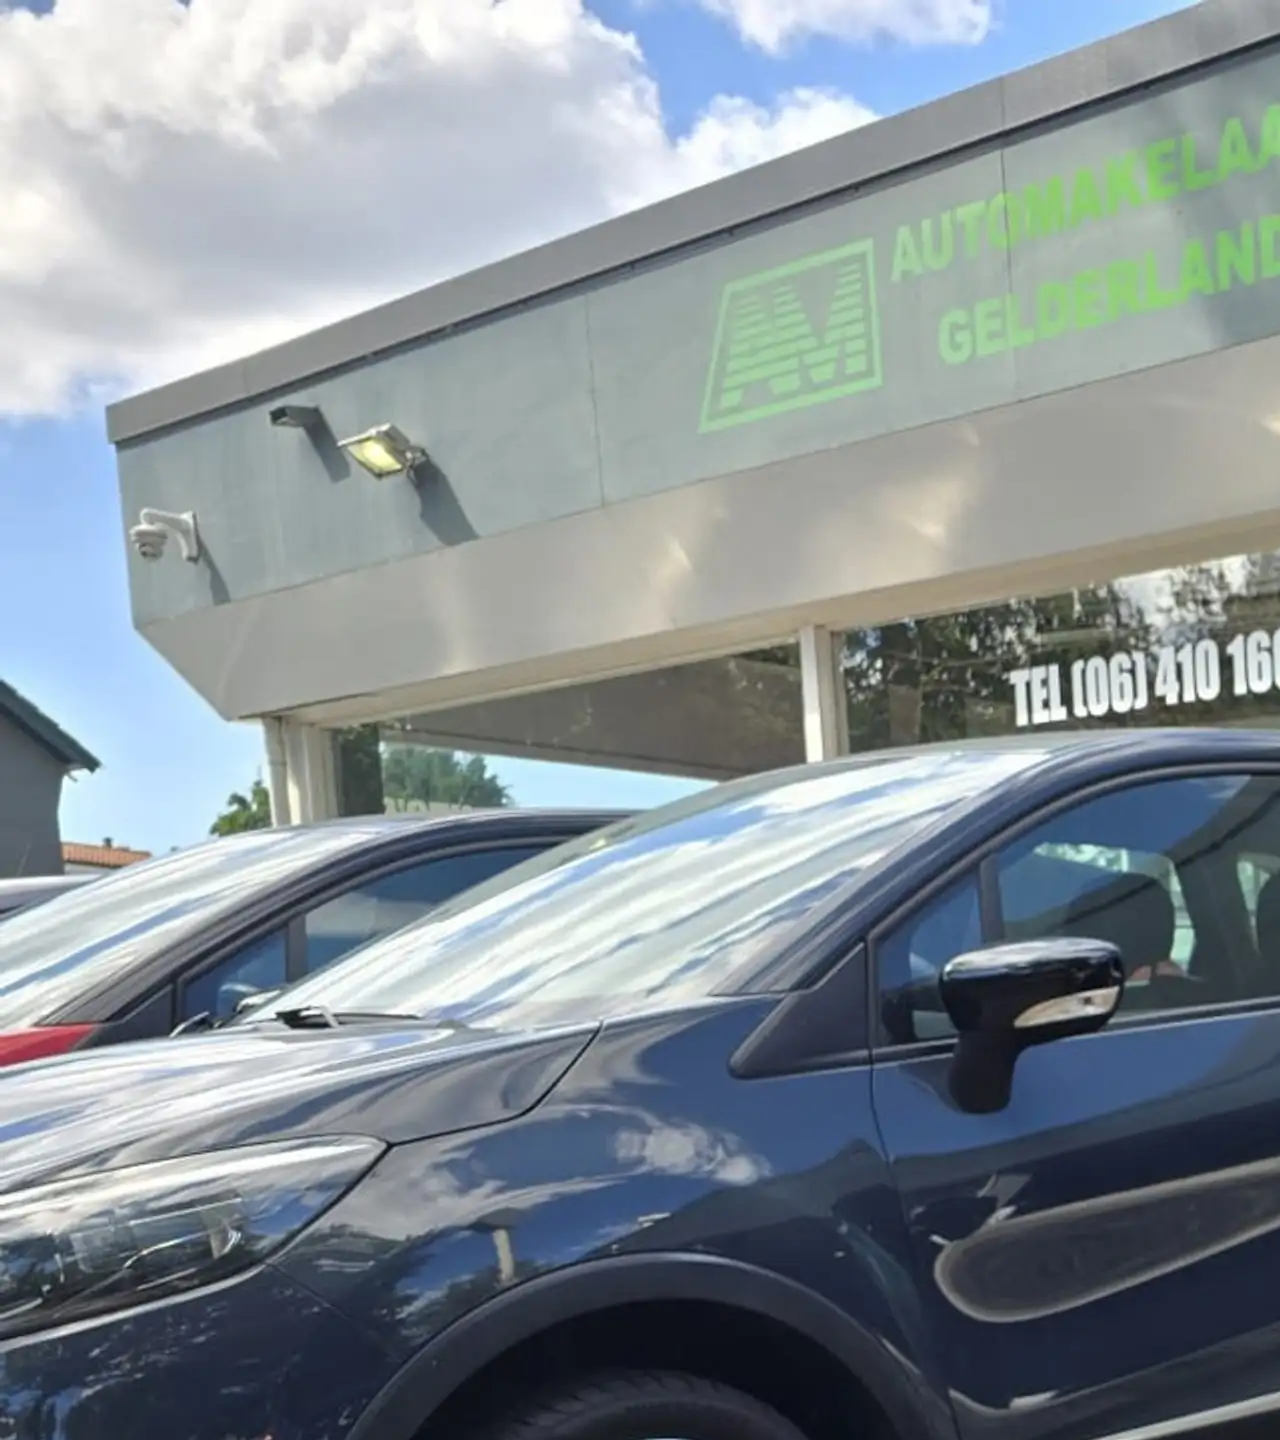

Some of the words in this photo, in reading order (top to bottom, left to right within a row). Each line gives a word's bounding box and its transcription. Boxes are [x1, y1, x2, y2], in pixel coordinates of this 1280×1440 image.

[1008, 664, 1067, 727] TEL
[1071, 650, 1149, 719] (06)
[1154, 638, 1221, 705] 410
